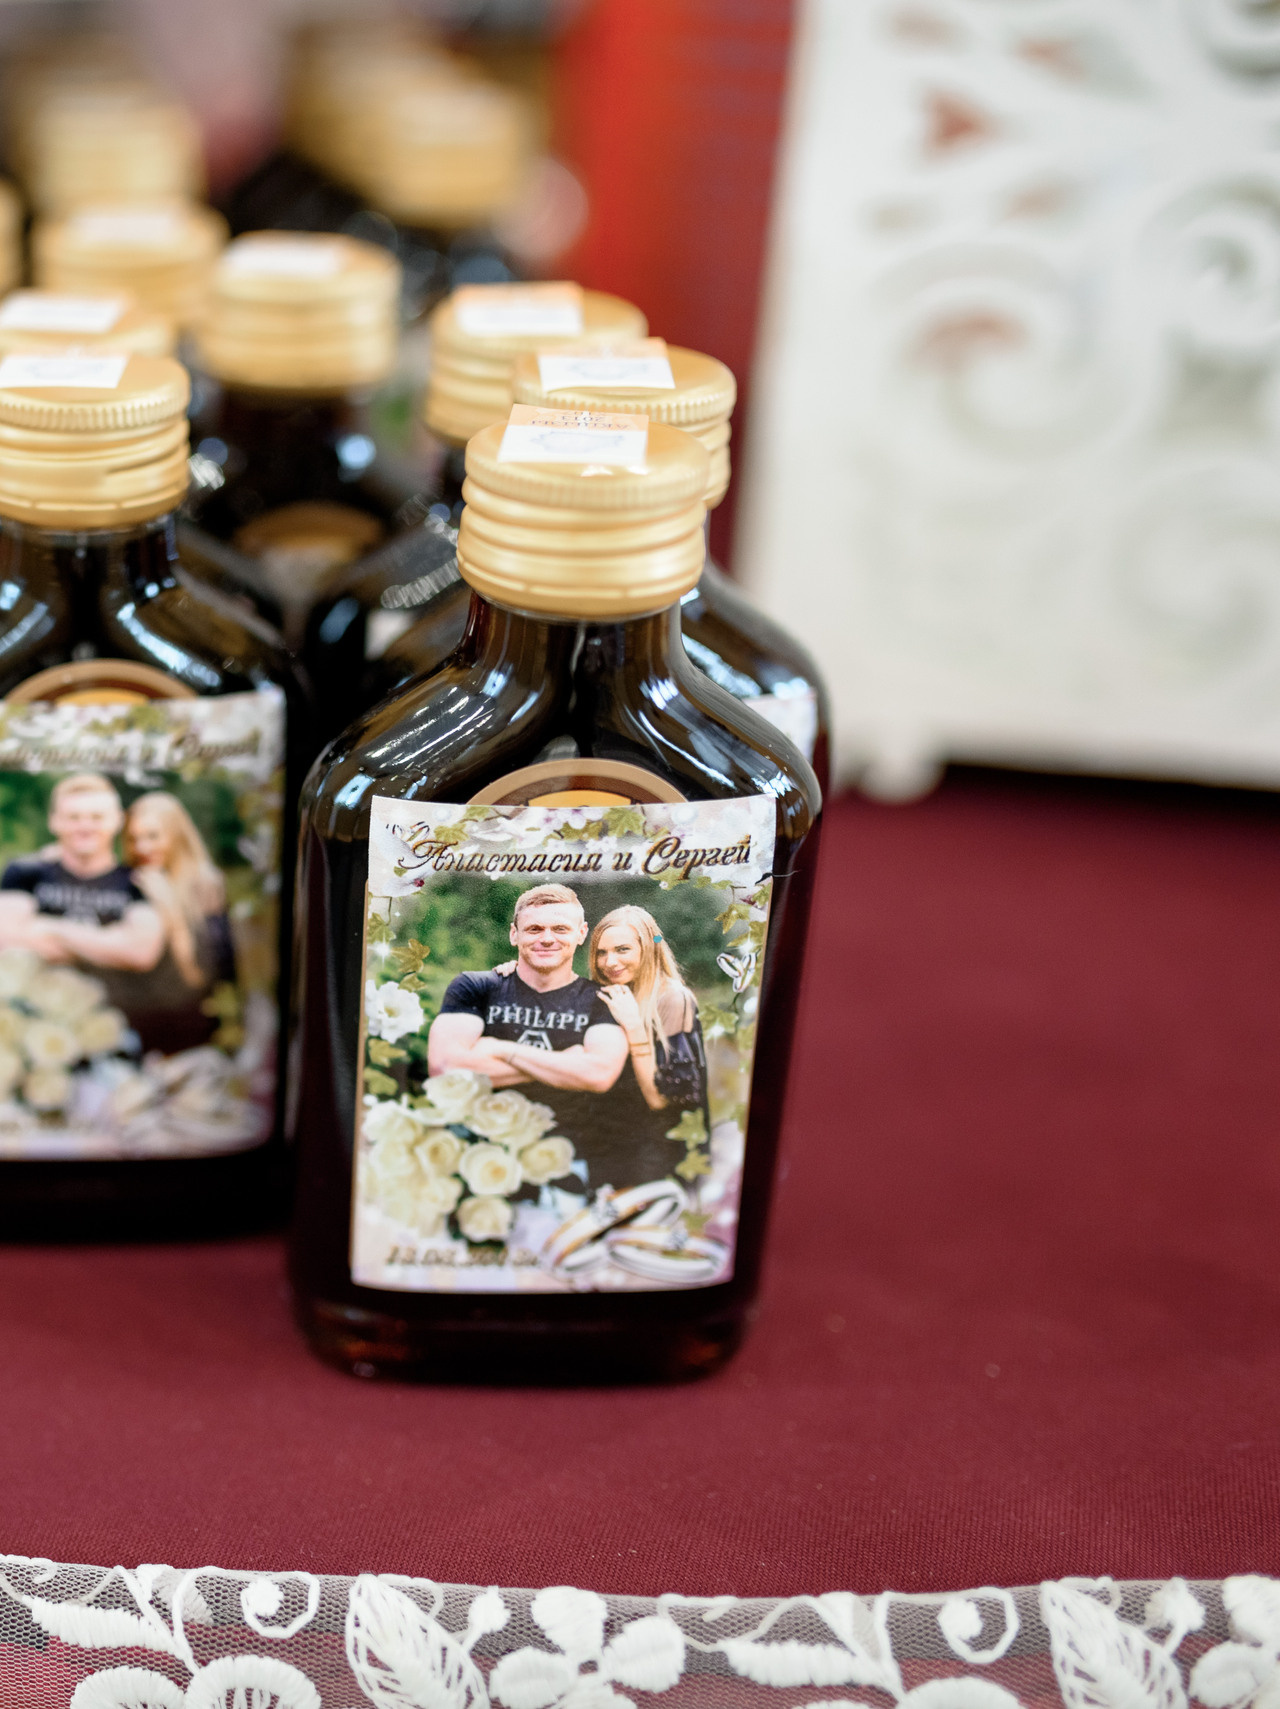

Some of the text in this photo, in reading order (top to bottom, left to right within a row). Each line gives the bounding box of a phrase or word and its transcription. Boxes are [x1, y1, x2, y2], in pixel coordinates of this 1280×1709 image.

[397, 833, 753, 880] Анастасия и Сергей
[486, 1004, 590, 1033] PHILIPP
